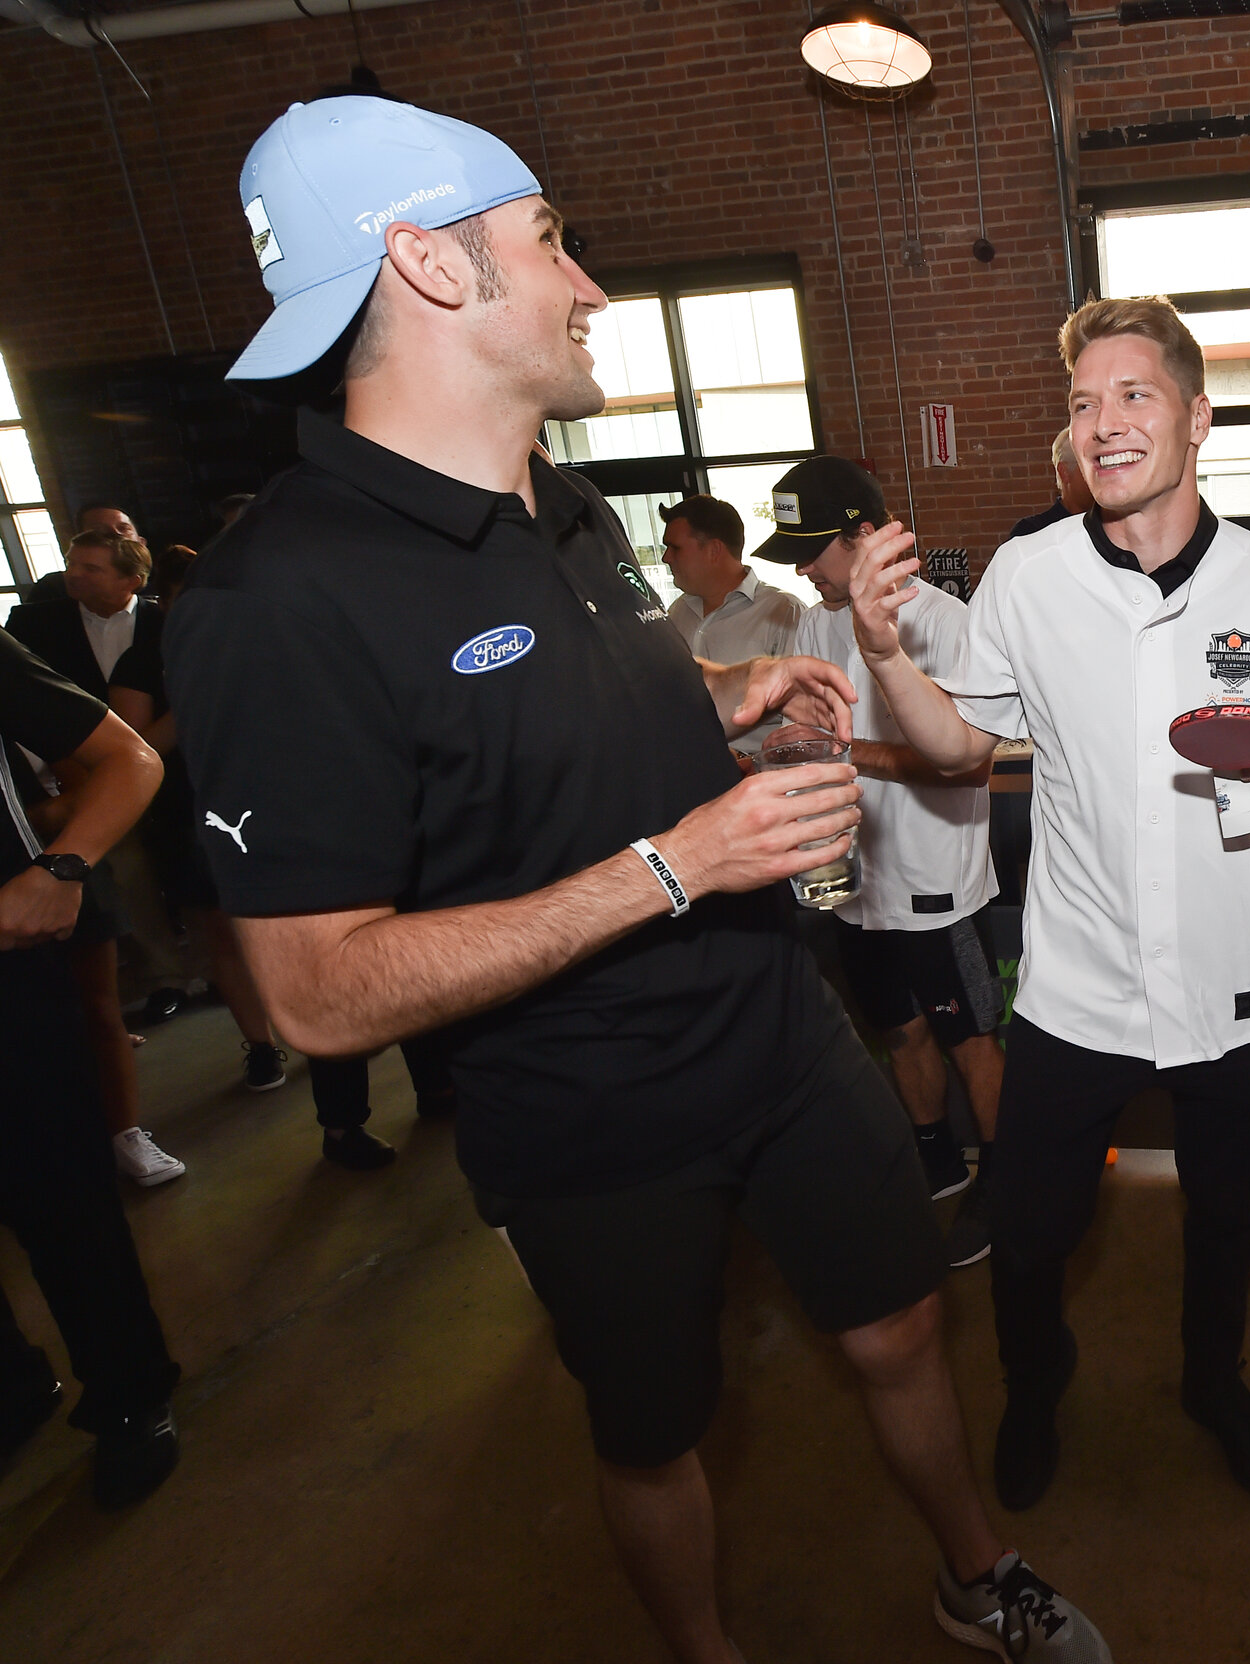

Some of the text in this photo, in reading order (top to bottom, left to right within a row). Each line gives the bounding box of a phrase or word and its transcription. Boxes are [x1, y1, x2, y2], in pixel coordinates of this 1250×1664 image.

[354, 183, 456, 234] TaylorMade
[472, 634, 523, 667] Ford
[1208, 653, 1224, 661] JOSEF
